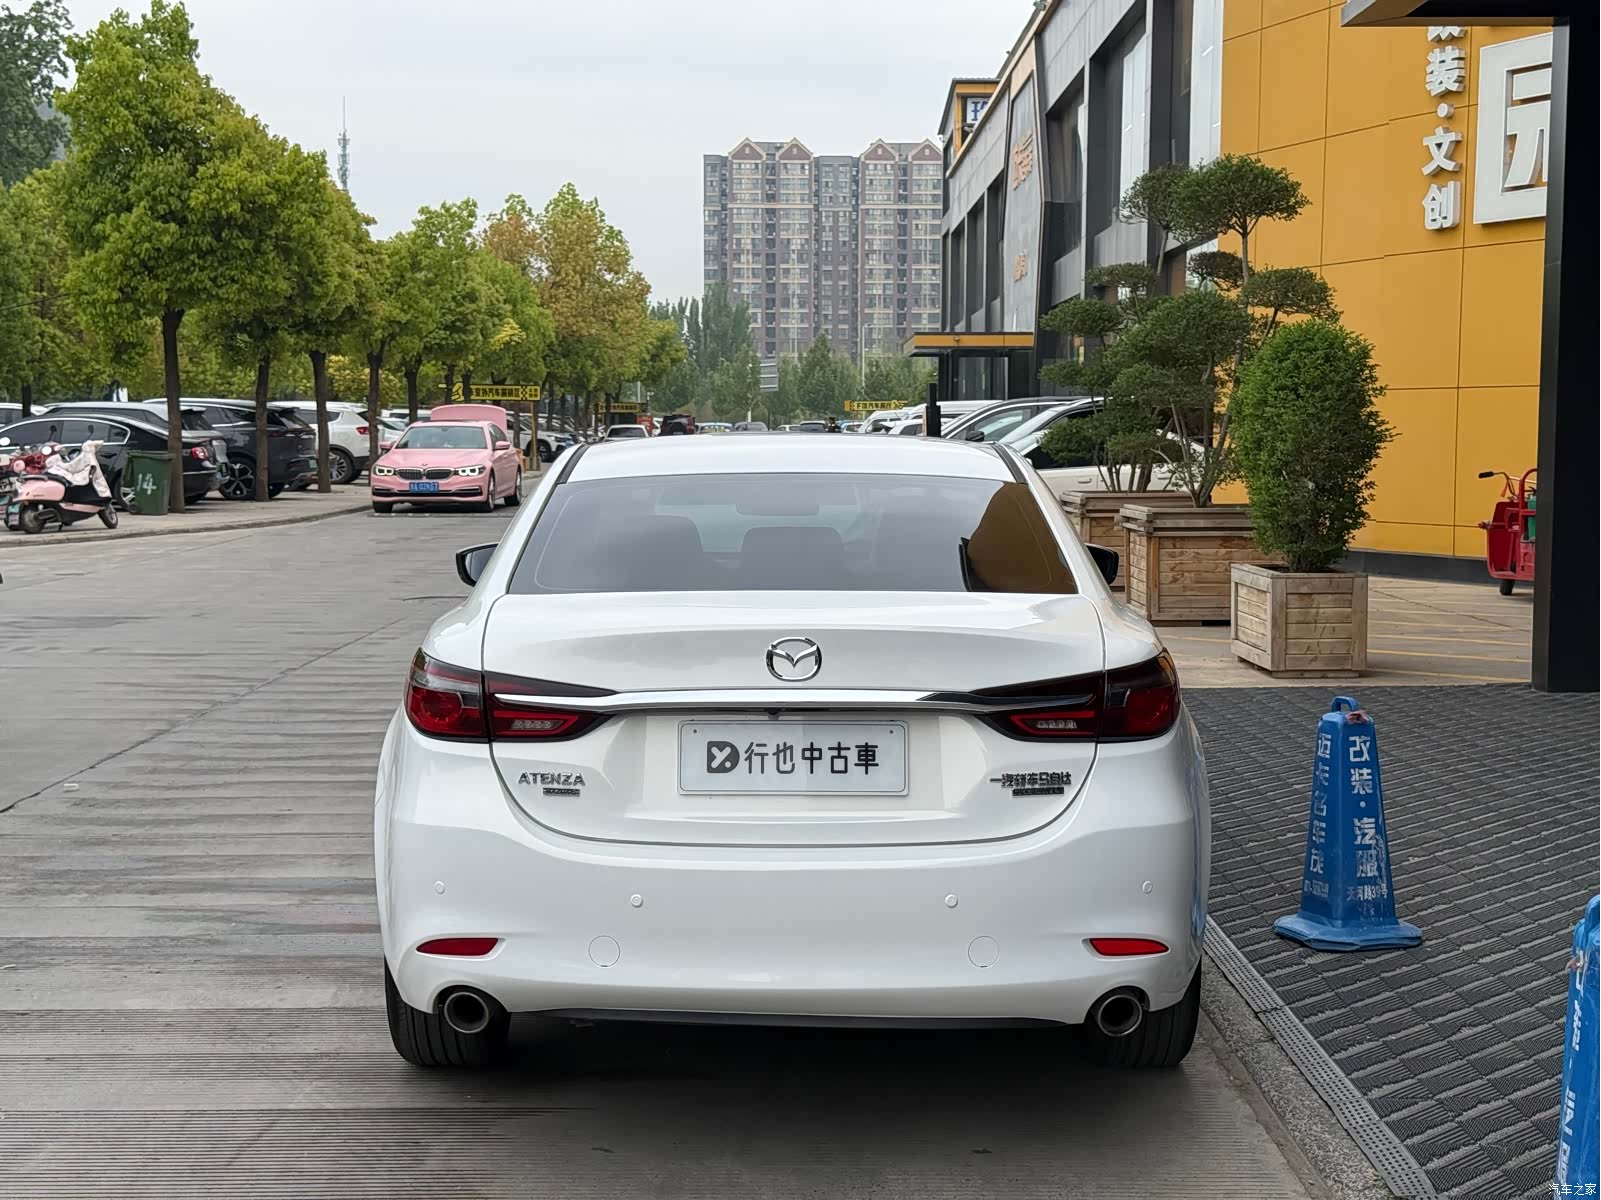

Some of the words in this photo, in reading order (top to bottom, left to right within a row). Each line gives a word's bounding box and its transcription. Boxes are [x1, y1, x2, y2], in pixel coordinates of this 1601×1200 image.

[136, 473, 157, 495] 14
[744, 741, 880, 775] 行也中古車
[518, 771, 586, 787] ATENZA
[989, 771, 1073, 788] 一汽轿车马自达
